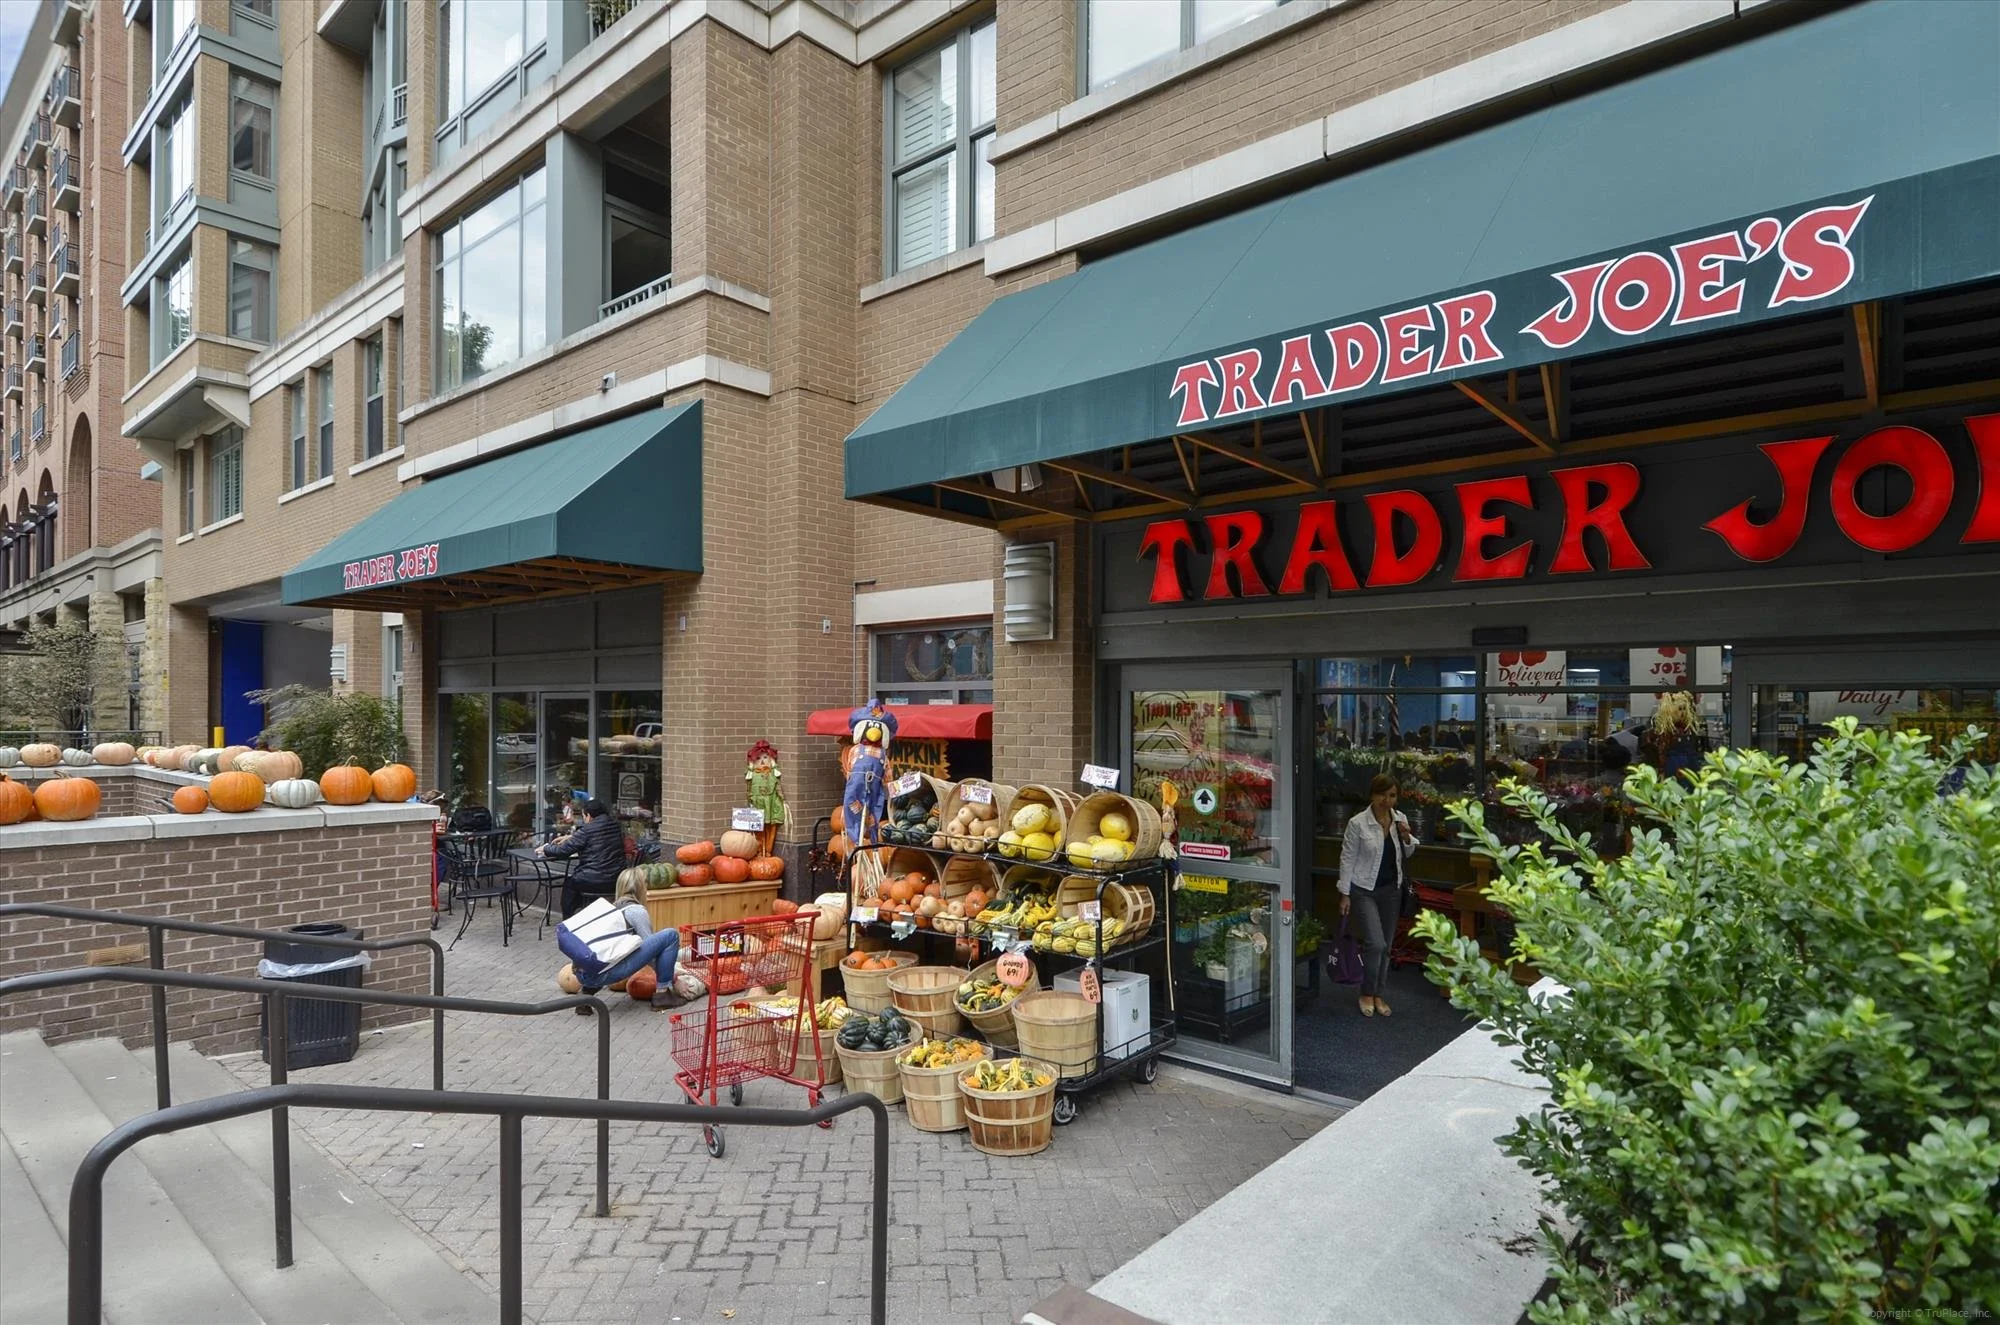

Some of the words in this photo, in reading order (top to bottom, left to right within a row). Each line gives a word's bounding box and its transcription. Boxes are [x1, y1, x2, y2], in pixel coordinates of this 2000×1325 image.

[1168, 289, 1505, 427] TRADER
[1517, 194, 1875, 349] JOE'S
[1135, 461, 1653, 604] TRADER
[343, 554, 396, 590] TRADER
[396, 542, 440, 580] JOE'S
[1498, 665, 1566, 682] Delivered
[1649, 662, 1688, 674] JOE'
[1837, 690, 1905, 715] Daily!
[887, 741, 941, 766] MPKIN
[1188, 875, 1220, 886] CAUTION
